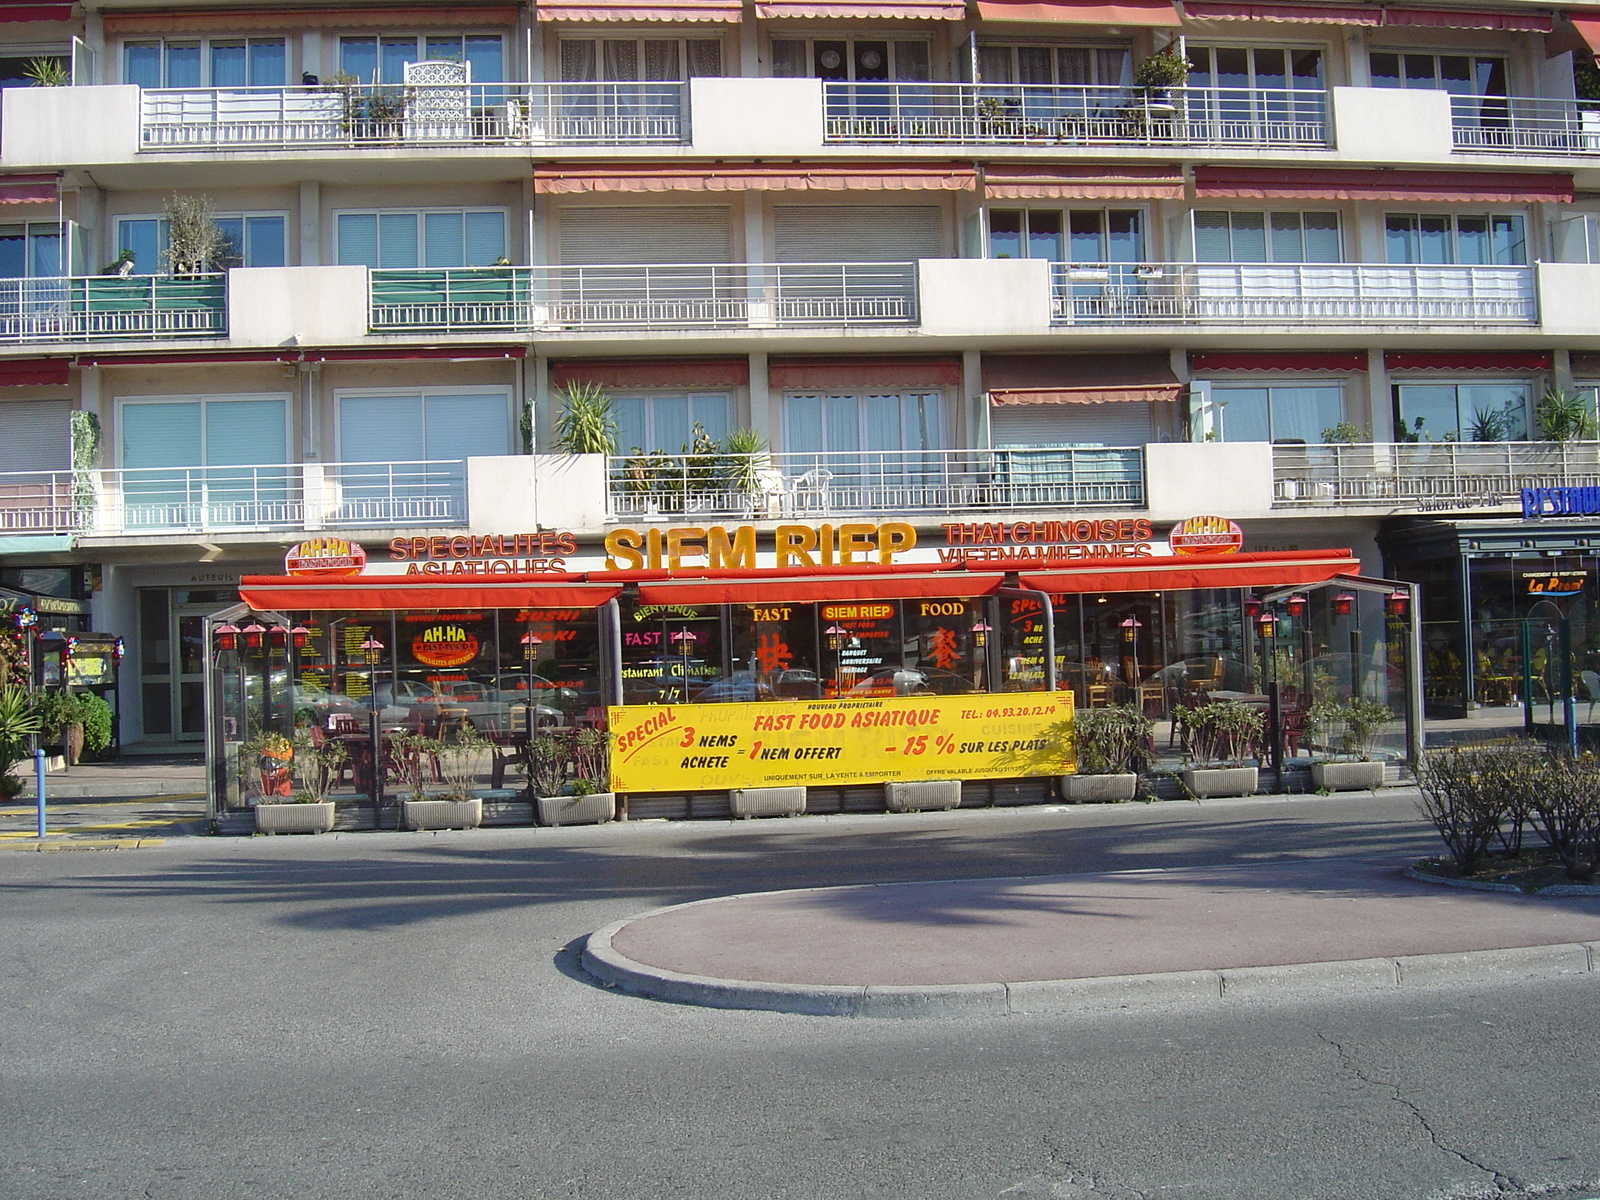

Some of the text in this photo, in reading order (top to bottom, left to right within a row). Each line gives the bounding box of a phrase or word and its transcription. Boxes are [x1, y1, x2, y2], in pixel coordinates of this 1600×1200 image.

[1417, 496, 1453, 513] Salon
[1521, 486, 1600, 519] RESTAU
[941, 518, 1154, 546] THAI CHINOISES
[388, 531, 578, 561] SPECIALITES
[604, 522, 918, 571] SIEM RIEP
[191, 573, 234, 582] AUTEUIL
[1528, 578, 1544, 593] La
[921, 602, 965, 617] FOOD
[1011, 594, 1066, 614] SPEAL
[515, 610, 581, 622] SUSHI
[633, 604, 698, 622] BIENVENUE
[753, 607, 792, 622] FAST
[825, 605, 890, 619] SIEM RIEP
[1023, 620, 1033, 633] 3
[625, 631, 662, 646] FAST
[756, 632, 793, 676] 快
[620, 667, 664, 679] staurant
[807, 700, 884, 711] NOUVEAU PROPRIETAIRE
[985, 704, 1056, 718] 04.93.20.12.14
[753, 709, 941, 732] FAST FOOD ASIATIQUE
[616, 706, 677, 753] SPECIAL
[680, 726, 738, 748] 3 NEMS
[749, 740, 763, 760] 1
[760, 747, 790, 760] NEM
[793, 746, 842, 760] OFFERT
[902, 735, 929, 756] 15
[935, 732, 955, 755] %
[959, 741, 983, 754] SUR
[987, 740, 1009, 752] LES
[1011, 738, 1048, 751] PLATS
[680, 755, 730, 769] ACHETE
[764, 773, 807, 781] UNIQUEMENT
[836, 771, 858, 779] VENTE
[864, 770, 901, 778] EMPORTER
[926, 768, 946, 776] OFFRE
